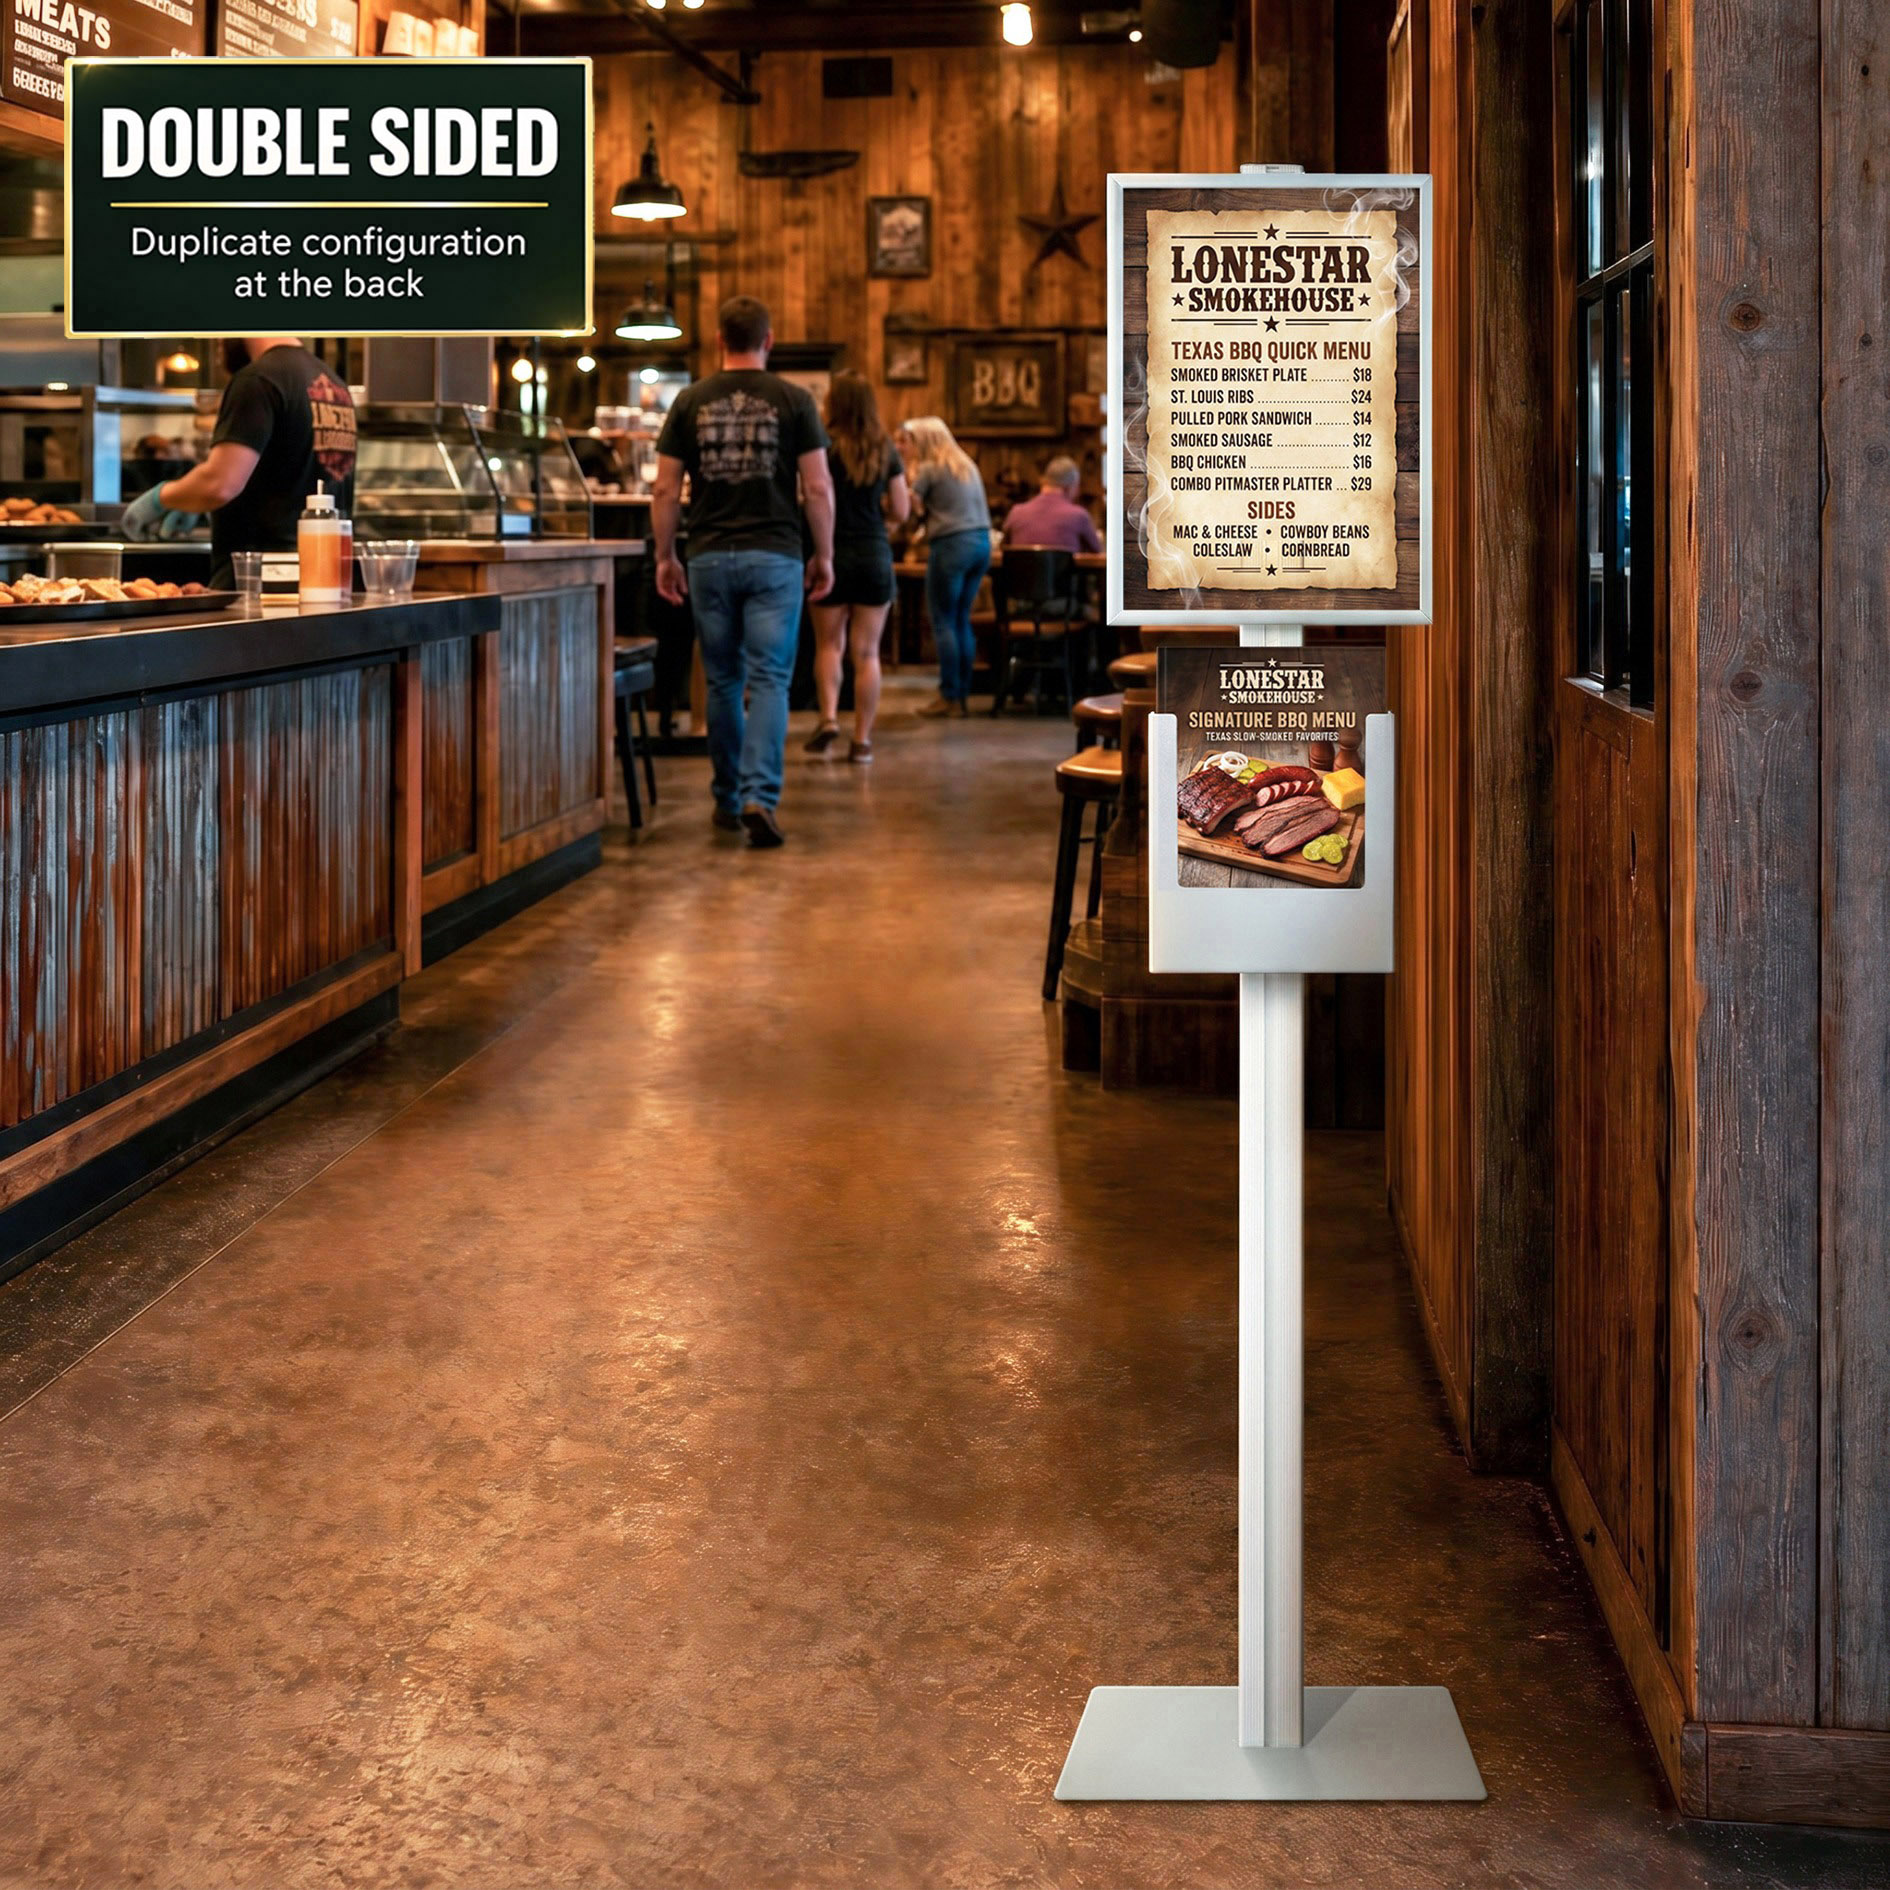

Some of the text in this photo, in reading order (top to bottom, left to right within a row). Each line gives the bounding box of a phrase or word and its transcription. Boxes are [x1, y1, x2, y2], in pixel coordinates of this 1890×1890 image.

[14, 0, 111, 50] MEATS
[1171, 245, 1372, 284] LONESTAR
[1188, 287, 1355, 313] SMOKEHOUSE
[1171, 341, 1371, 362] TEXAS BBQ QUICK MENU
[1171, 367, 1372, 383] SMOKED BRISKET PLATE $18
[972, 360, 1041, 407] BBQ
[1171, 389, 1372, 404] ST. LOUIS RIBS $24
[1171, 411, 1372, 426] PULLED PORK SANDWICH $14
[1171, 432, 1372, 448] SMOKED SAUSAGE $12
[1171, 454, 1372, 470] BBQ CHICKEN $16
[1171, 476, 1372, 491] COMBO PITMASTER PLATTER $29
[1247, 500, 1296, 520] SIDES
[1173, 525, 1370, 540] MAC & CHEESE COWBOY BEANS
[1193, 543, 1350, 558] COLESLAW CORNBREAD
[1219, 669, 1325, 690] LONESTAR
[1229, 690, 1315, 704] SMOKEHOUSE
[1189, 711, 1356, 729] SIGNATURE BBQ MENU
[1206, 731, 1339, 742] TEXAS SLOW-SMOKED FAVORITES
